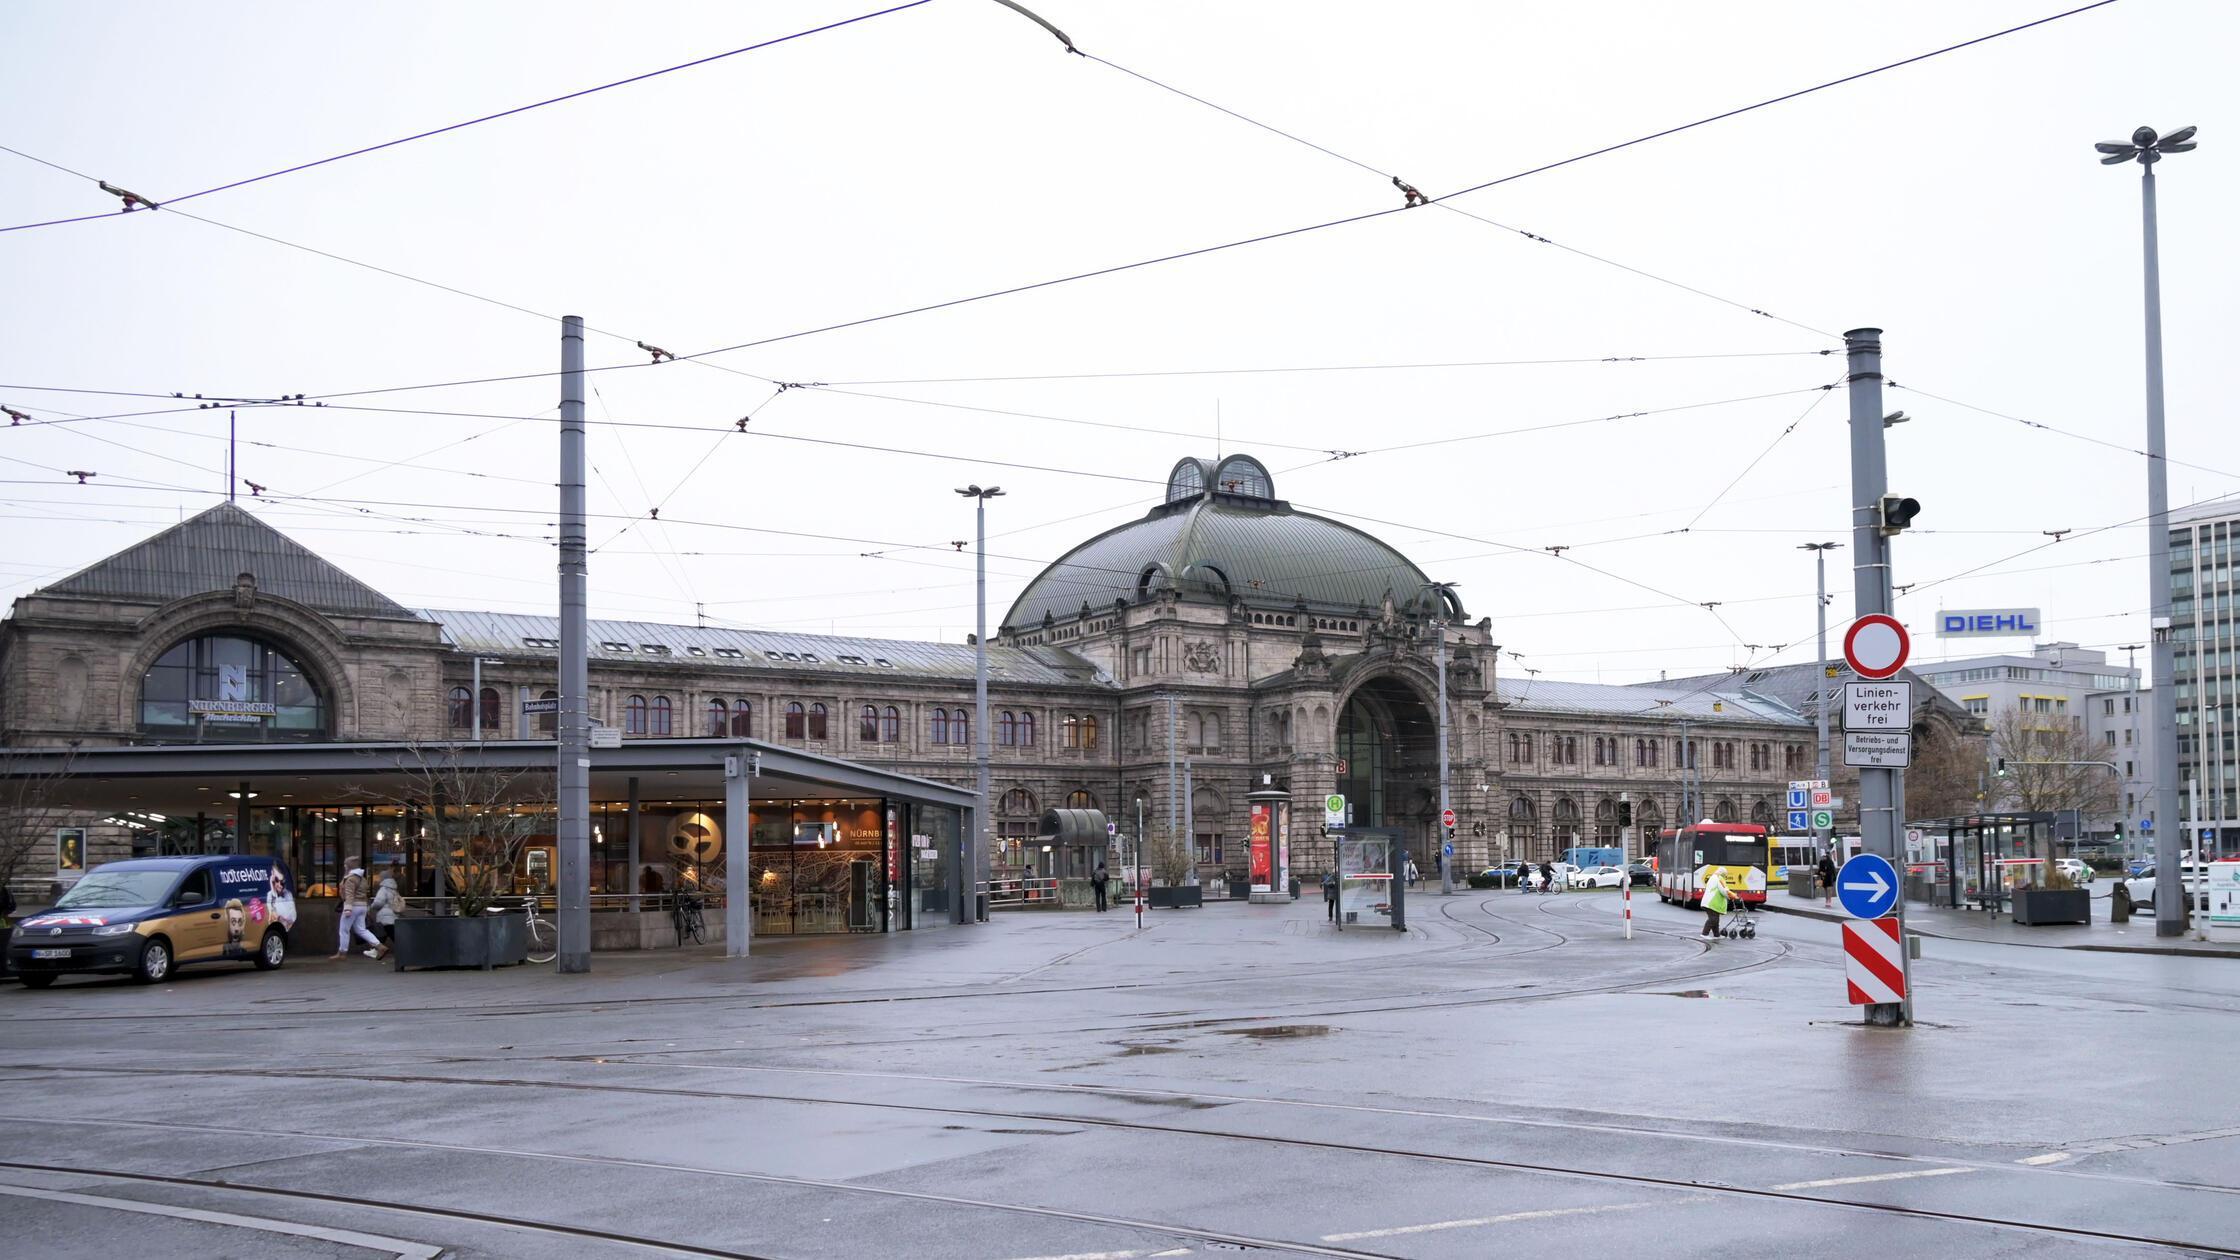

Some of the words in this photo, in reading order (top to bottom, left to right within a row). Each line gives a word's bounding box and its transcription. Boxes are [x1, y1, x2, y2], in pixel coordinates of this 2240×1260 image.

[1944, 614, 2034, 632] DIEHL
[1856, 687, 1899, 698] Linien-
[1853, 700, 1901, 711] verkehr
[1866, 713, 1888, 724] frei
[1855, 735, 1885, 744] Betriebs-
[1886, 736, 1899, 744] und
[1848, 745, 1906, 755] Versorgungsdienst
[1790, 791, 1804, 806] U
[1815, 794, 1828, 802] DB
[1331, 799, 1340, 809] H
[1817, 813, 1828, 826] S
